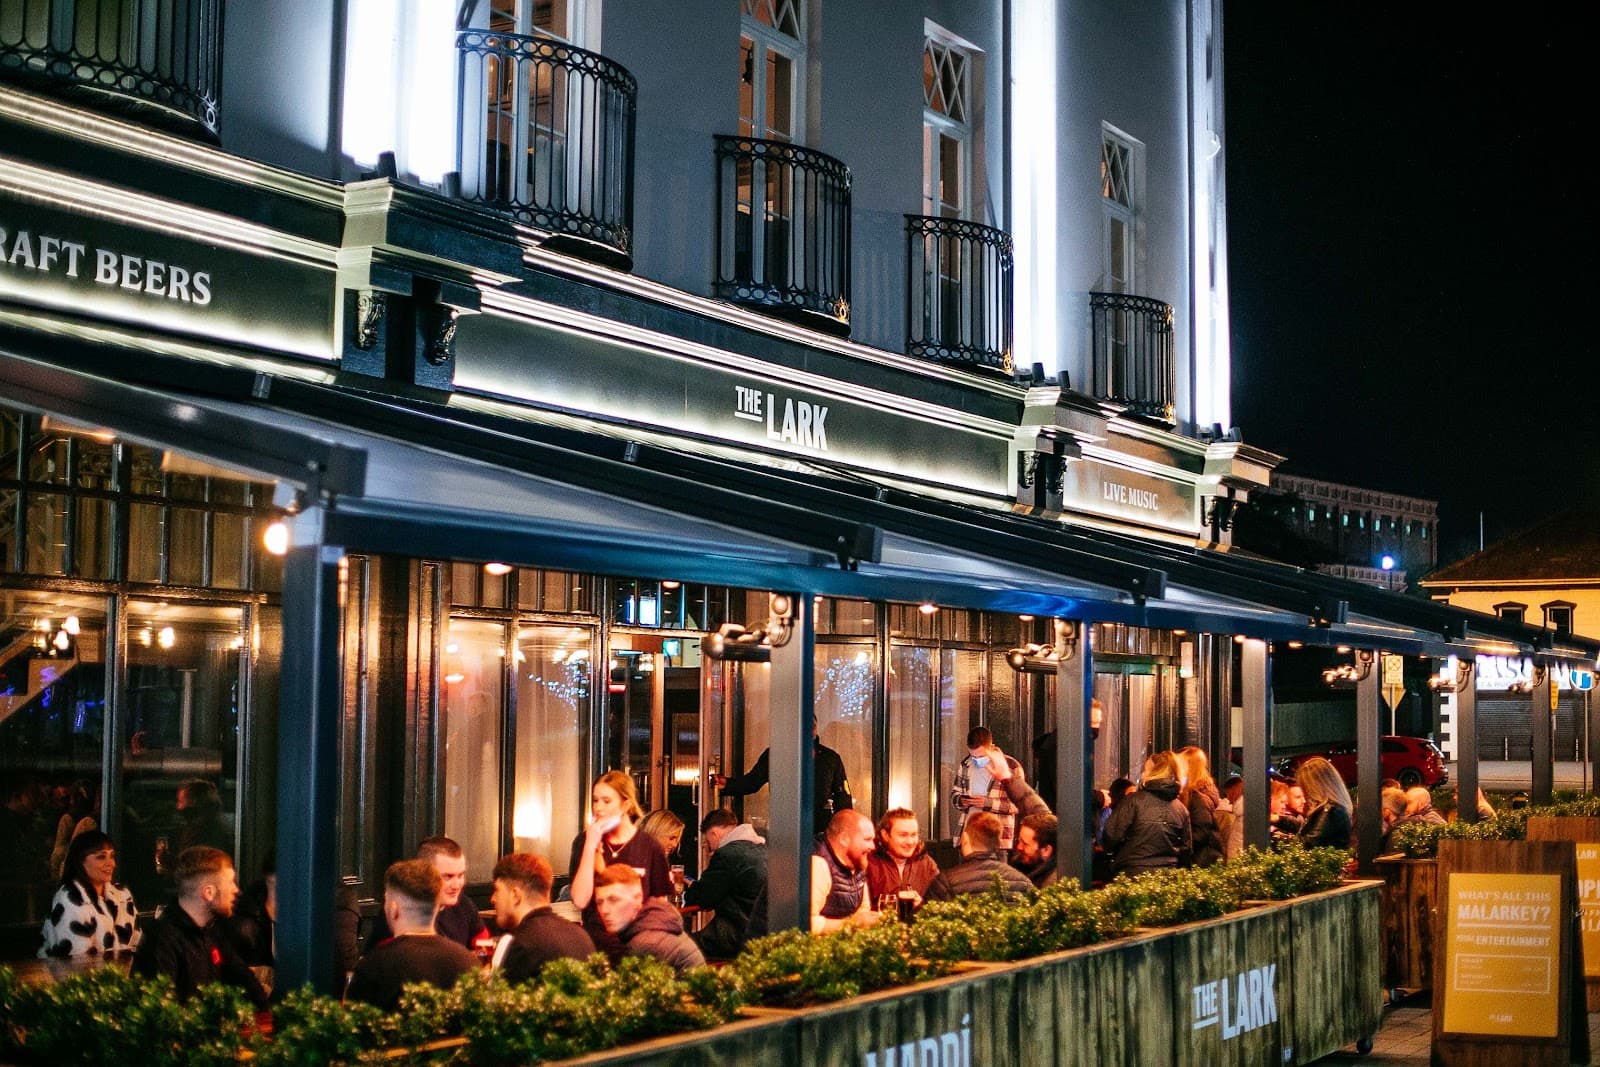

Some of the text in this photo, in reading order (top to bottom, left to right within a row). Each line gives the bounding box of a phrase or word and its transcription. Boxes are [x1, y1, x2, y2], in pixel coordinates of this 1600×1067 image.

[94, 248, 212, 305] BEERS
[735, 385, 829, 451] THE LARK
[1103, 481, 1159, 511] LIVE MUSIC
[1457, 904, 1551, 922] MALARKEY?
[1476, 934, 1551, 948] ENTERTAINMENT
[1193, 963, 1278, 1041] THE LARK
